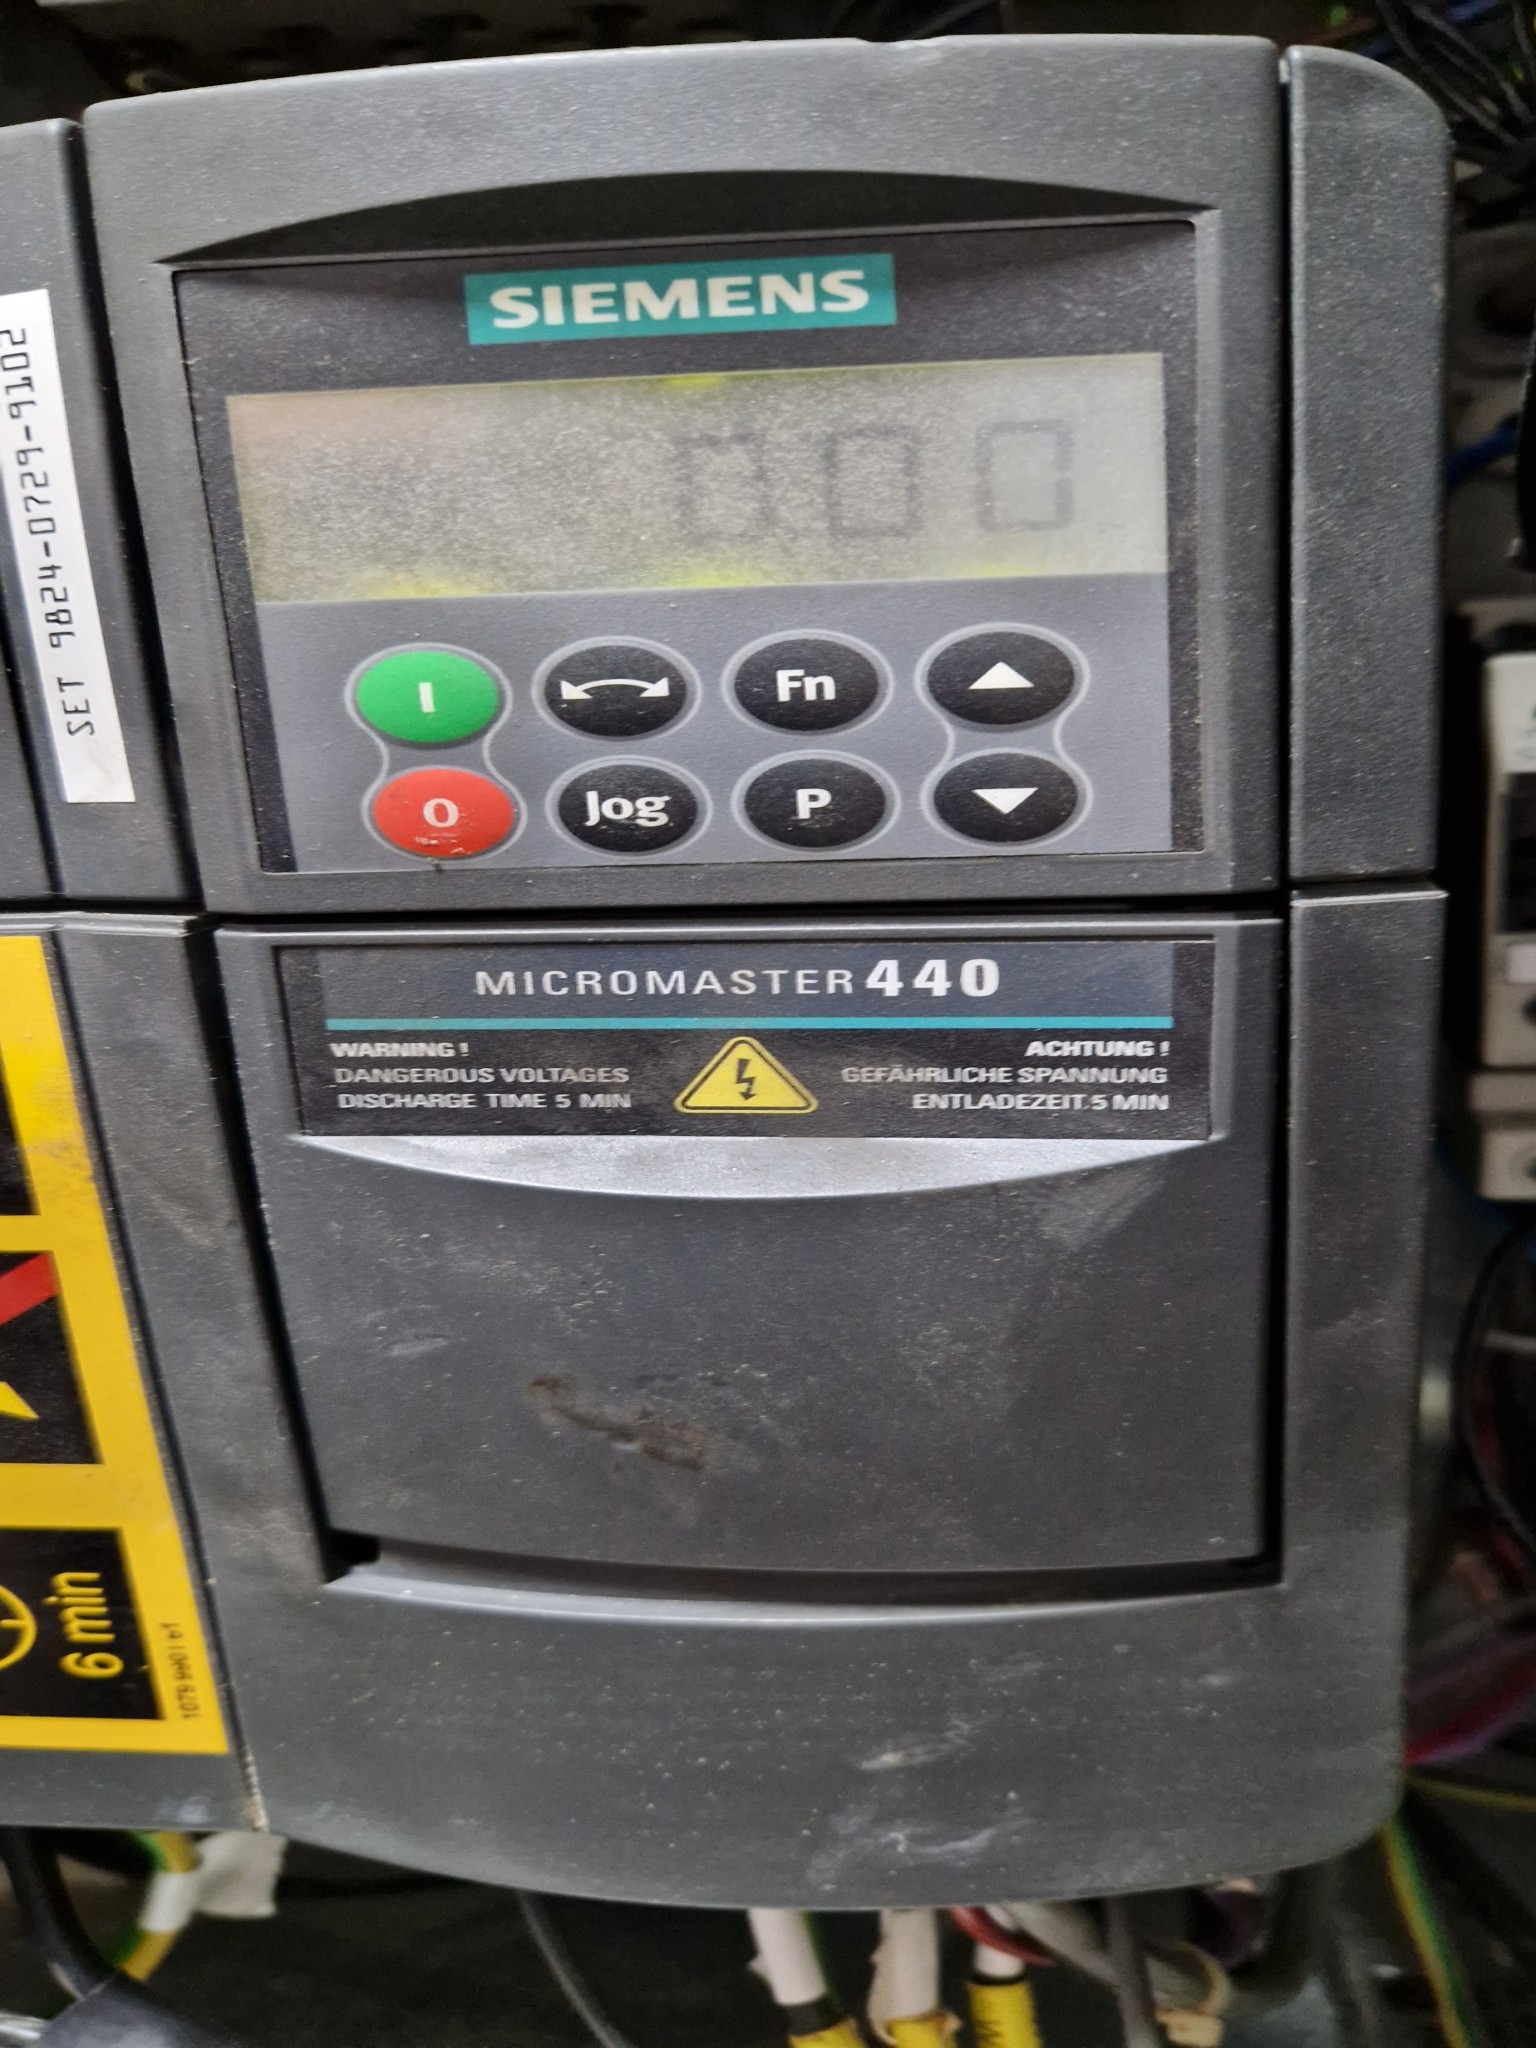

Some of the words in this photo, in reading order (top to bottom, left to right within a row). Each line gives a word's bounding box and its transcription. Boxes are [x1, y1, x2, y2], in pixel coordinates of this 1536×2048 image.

[489, 269, 870, 329] SIEMENS
[0, 327, 76, 649] 9824-0729-9102
[775, 669, 837, 703] Fn
[56, 676, 95, 737] SET
[584, 790, 672, 827] Jog
[796, 788, 833, 820] P
[475, 969, 854, 996] MICROMASTER
[865, 958, 1000, 997] 440
[329, 1042, 456, 1058] WARNING
[1023, 1040, 1155, 1058] ACHTUNG
[334, 1067, 495, 1084] DANGEROUS
[499, 1067, 631, 1084] VOLTAGES
[841, 1064, 1015, 1084] GEFÄHRLICHE
[1016, 1066, 1169, 1084] SPANNUNG
[337, 1092, 478, 1109] DISCHARGE
[484, 1092, 548, 1109] TIME
[555, 1093, 573, 1109] 5
[578, 1092, 633, 1109] MIN
[909, 1093, 1087, 1110] ENTLADEZEIT
[1090, 1094, 1109, 1111] 5
[1111, 1094, 1170, 1111] MIN
[43, 1571, 117, 1645] min
[58, 1650, 125, 1680] 6
